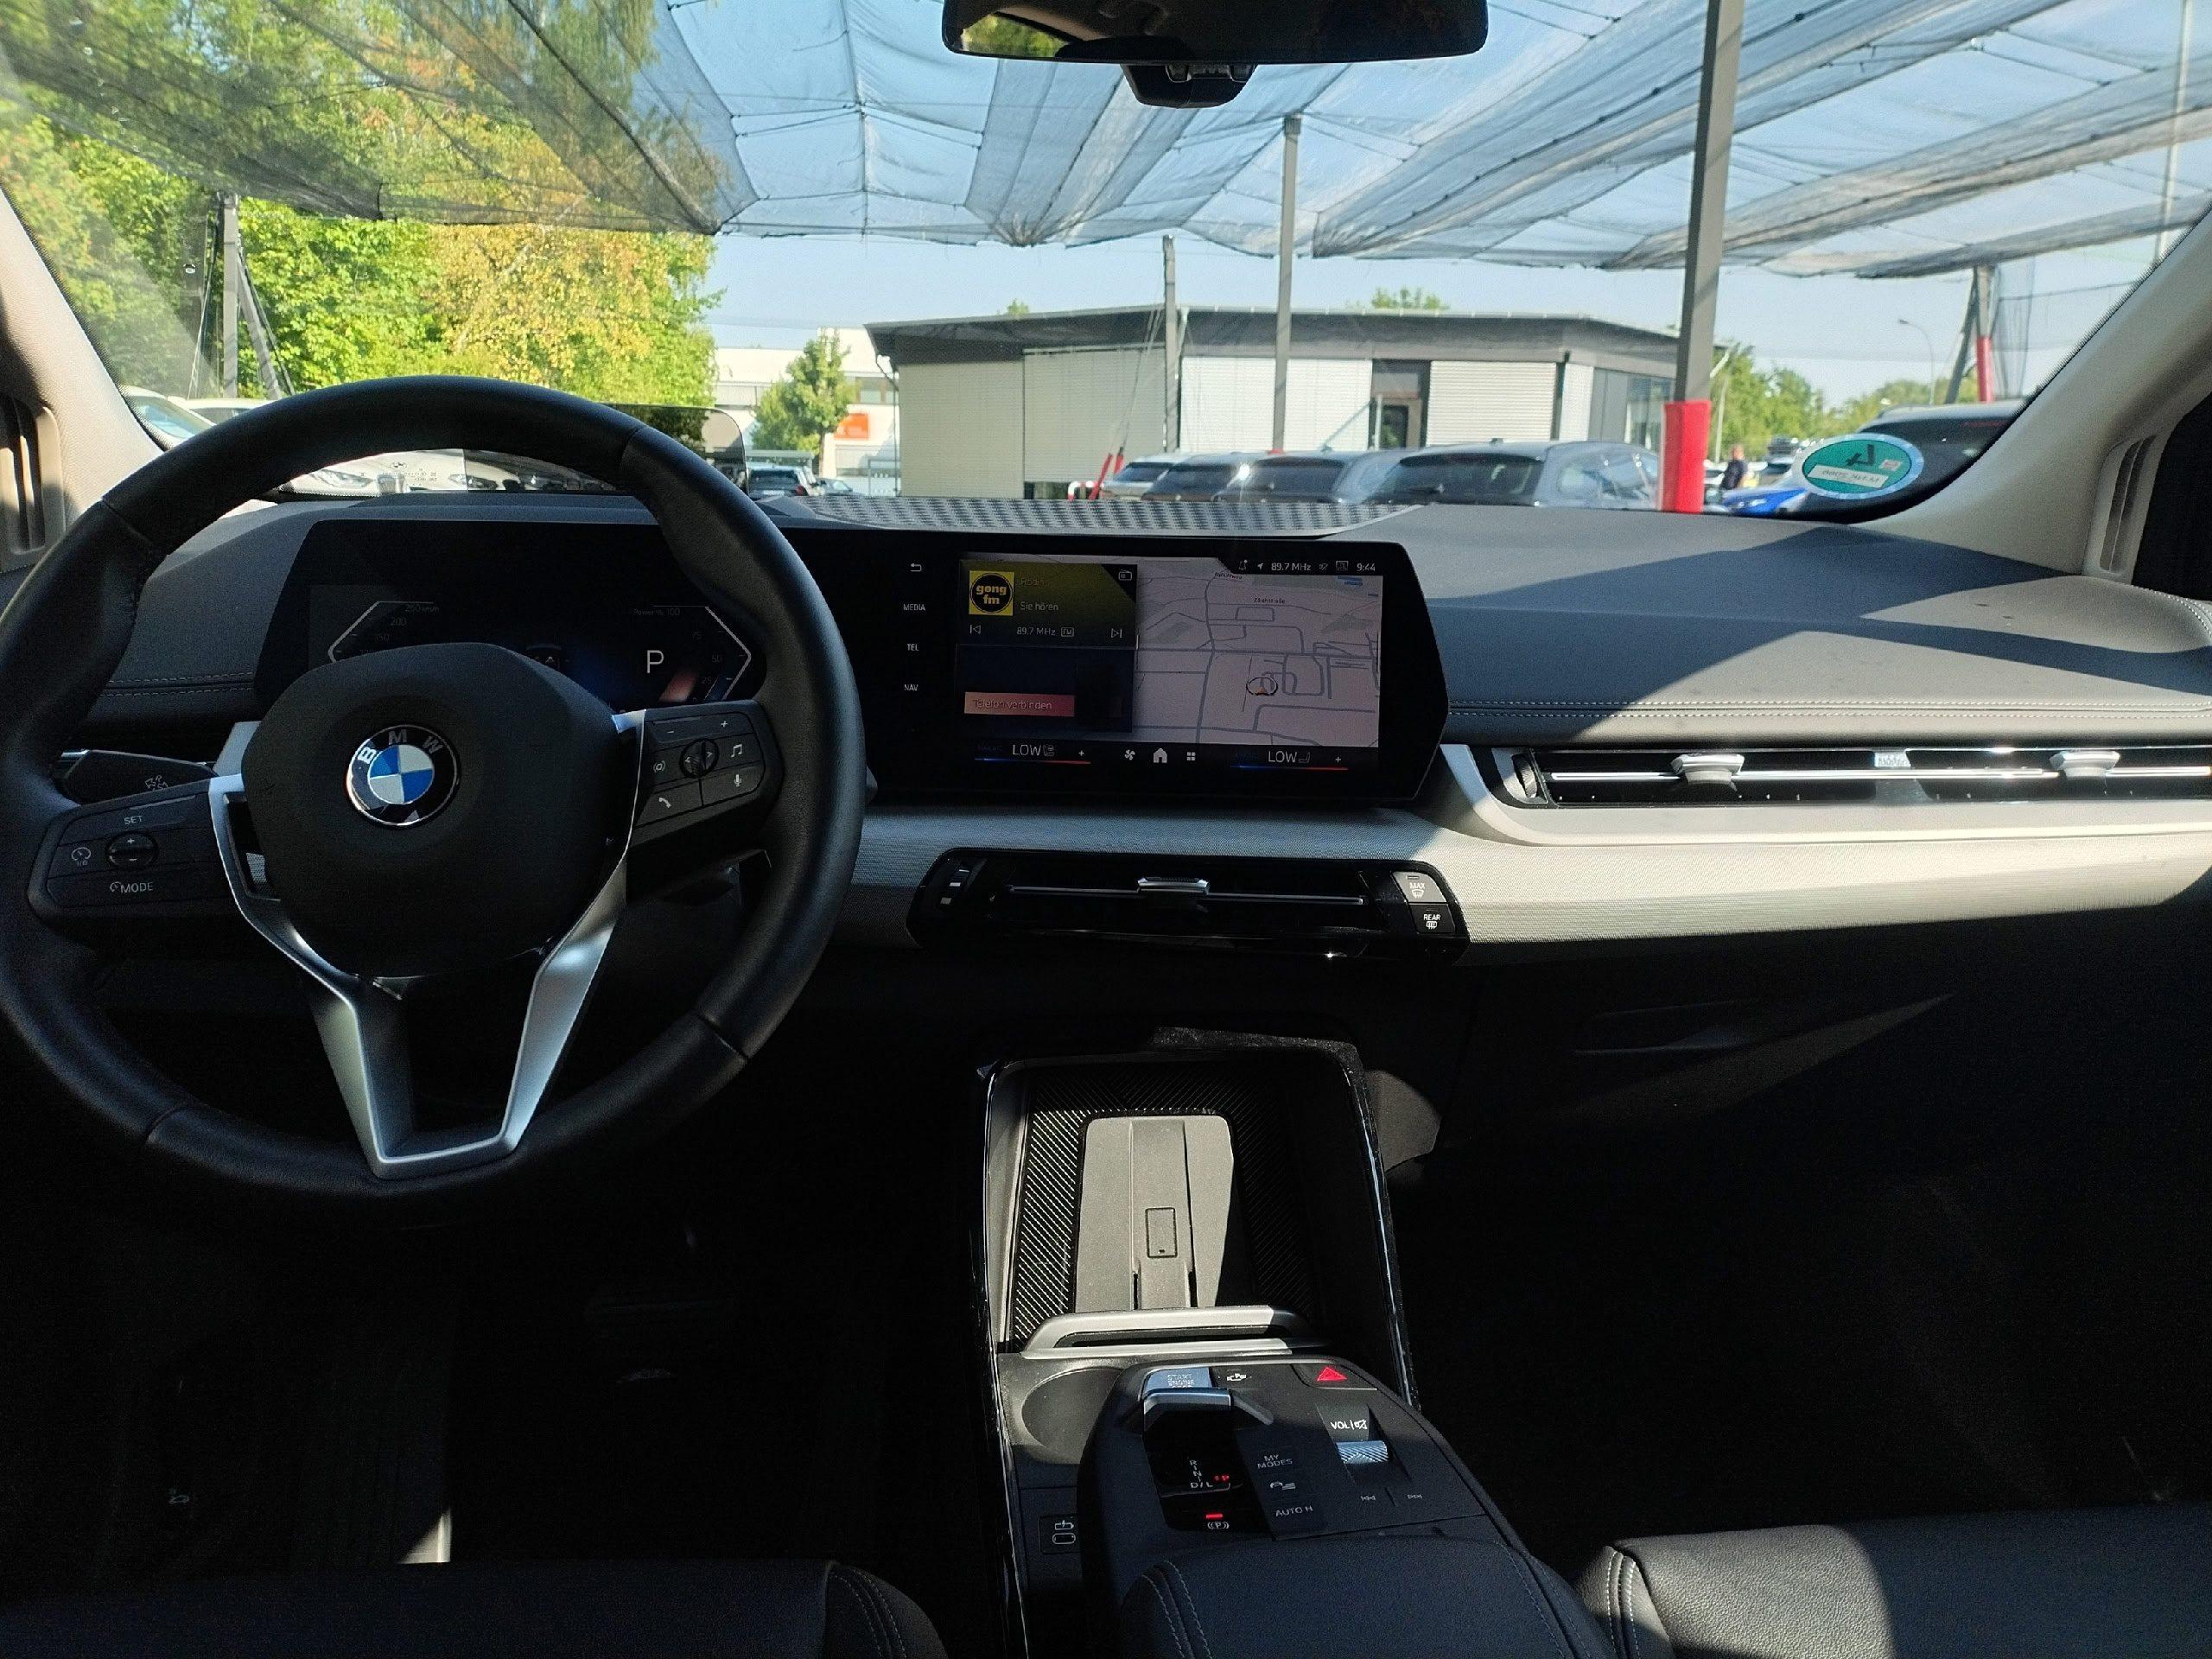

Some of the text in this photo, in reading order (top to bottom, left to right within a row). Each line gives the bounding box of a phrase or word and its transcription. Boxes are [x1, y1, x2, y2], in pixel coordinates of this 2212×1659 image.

[1271, 563, 1312, 572] 89.7 MHz
[1357, 563, 1376, 571] 9:44
[976, 584, 1007, 596] gong
[983, 594, 1001, 605] fm
[903, 603, 926, 612] MEDIA
[1020, 601, 1033, 611] Sie
[390, 616, 408, 626] 200
[1016, 626, 1034, 636] 89.7
[1036, 627, 1057, 637] MHz
[906, 643, 919, 652] TEL
[645, 649, 665, 674] P
[904, 683, 918, 692] NAV
[972, 698, 1052, 711] Telefon verbinden
[1012, 743, 1041, 757] LOW
[1268, 749, 1298, 764] LOW
[124, 815, 143, 825] SET
[120, 881, 155, 893] MODE
[1263, 1453, 1280, 1463] MY
[1256, 1458, 1294, 1470] MODES
[1274, 1504, 1314, 1517] AUTO H
